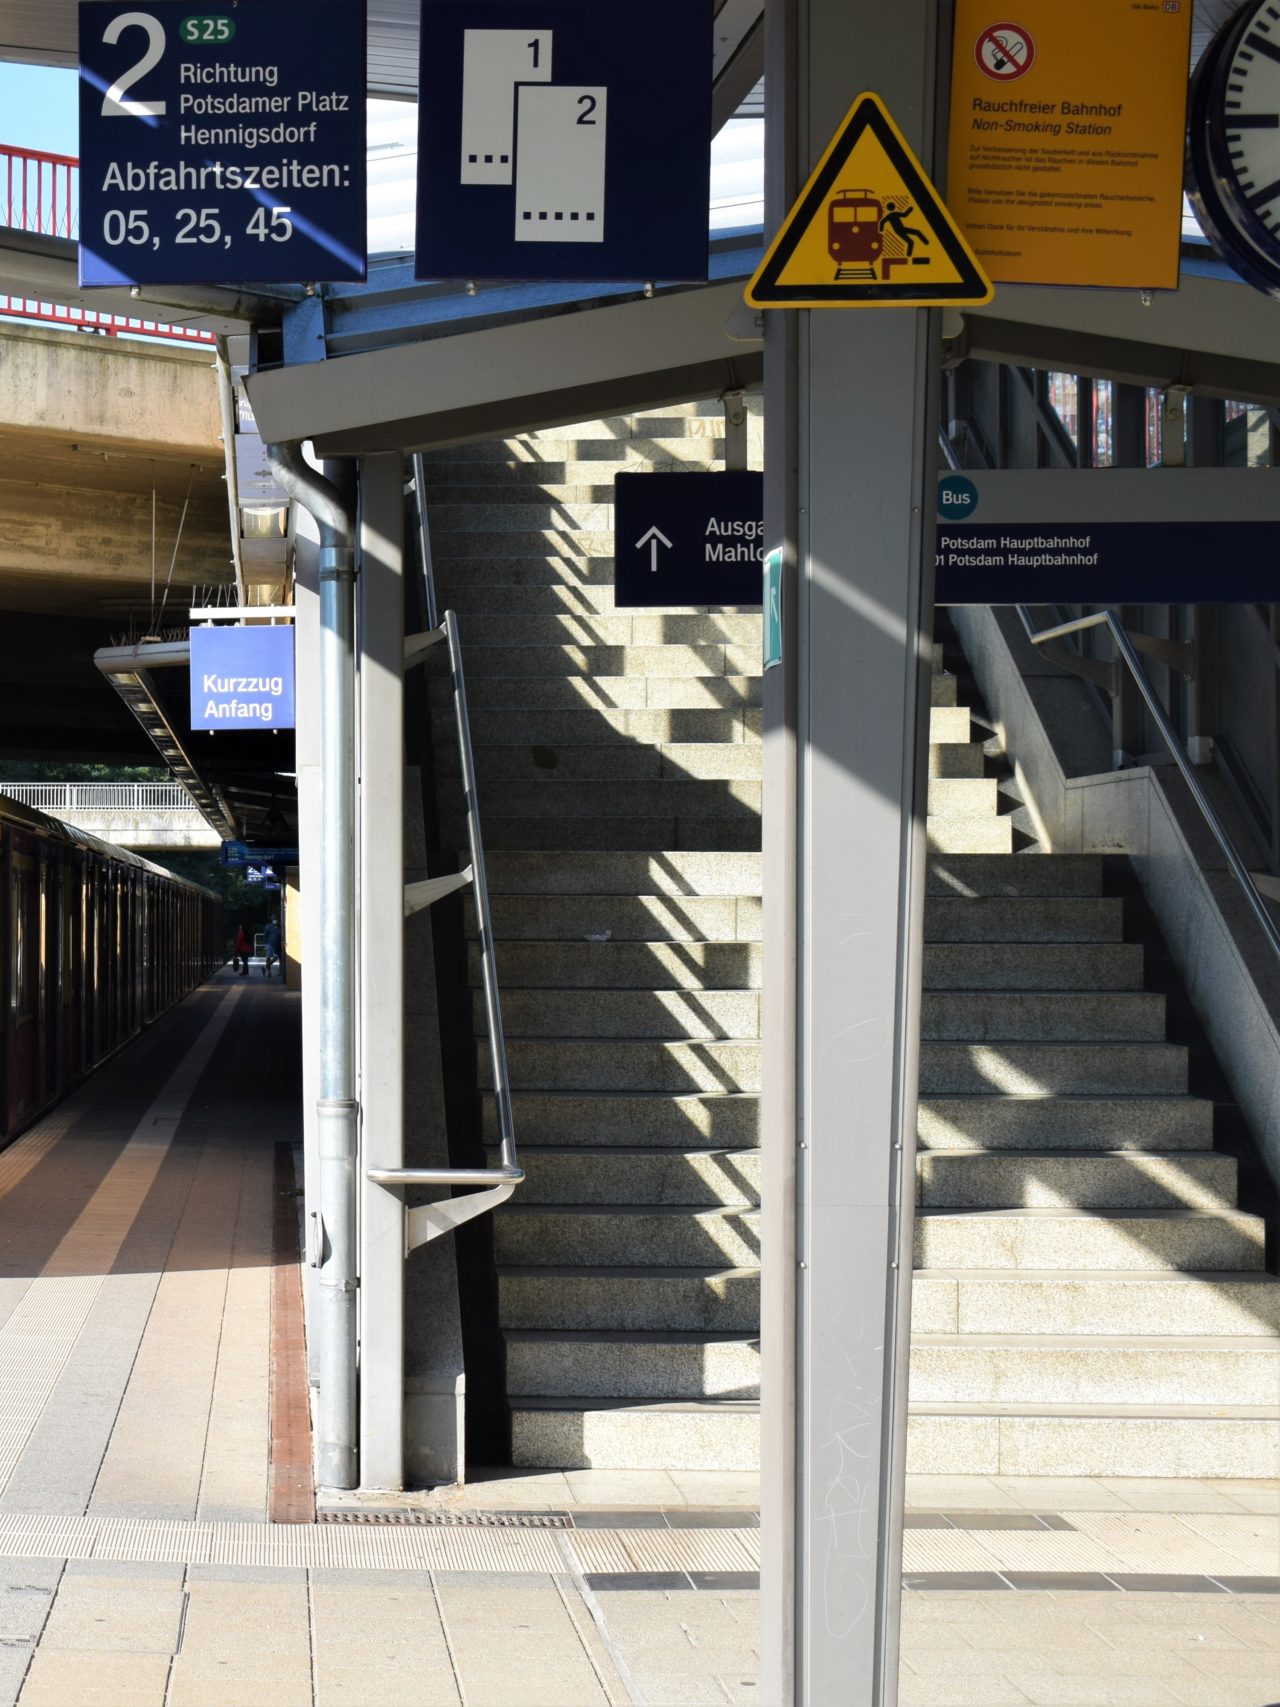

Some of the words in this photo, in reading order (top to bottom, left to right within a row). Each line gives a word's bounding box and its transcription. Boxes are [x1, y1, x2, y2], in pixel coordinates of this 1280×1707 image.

[186, 19, 230, 40] S25
[101, 12, 166, 116] 2
[527, 38, 540, 69] 1
[180, 63, 278, 87] Richtung
[180, 93, 291, 115] Potsdamer
[297, 91, 349, 112] Platz
[576, 95, 597, 126] 2
[972, 98, 1057, 116] Rauchfreier
[1060, 102, 1123, 118] Bahnhof
[180, 122, 317, 149] Hennigsdorf
[971, 118, 1062, 136] Non-Smoking
[1065, 121, 1113, 136] Station
[101, 158, 350, 192] Abfahrtszeiten:
[103, 208, 160, 250] 05,
[174, 207, 232, 249] 25,
[245, 206, 293, 242] 45
[942, 490, 971, 505] Bus
[941, 537, 997, 550] Potsdam
[1000, 536, 1091, 551] Hauptbahnhof
[949, 554, 1004, 567] Potsdam
[1008, 553, 1099, 568] Hauptbahnhof
[203, 674, 283, 696] Kurzzug
[204, 699, 273, 721] Anfang
